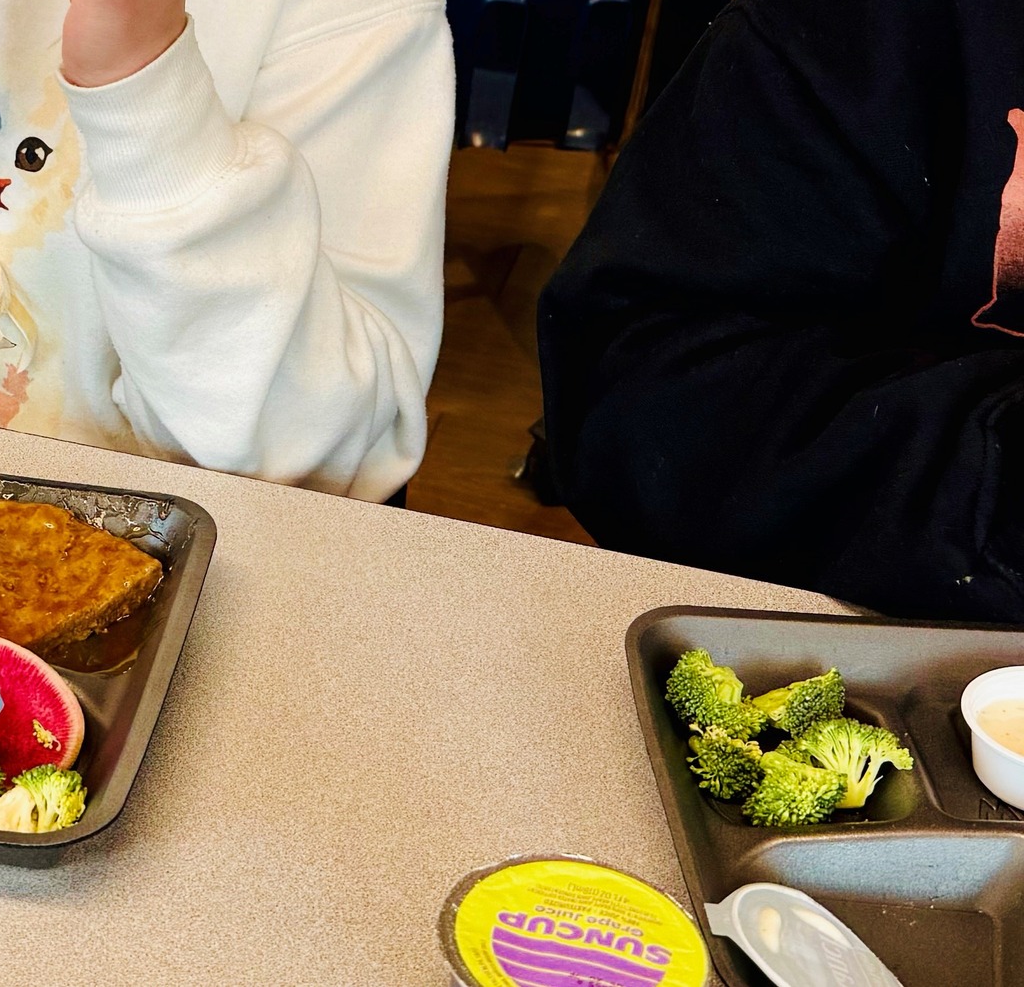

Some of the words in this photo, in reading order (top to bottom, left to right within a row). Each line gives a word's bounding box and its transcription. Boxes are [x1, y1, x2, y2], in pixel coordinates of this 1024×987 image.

[534, 905, 584, 922] Juice
[586, 914, 644, 937] Grape
[498, 910, 673, 966] SUNCUP
